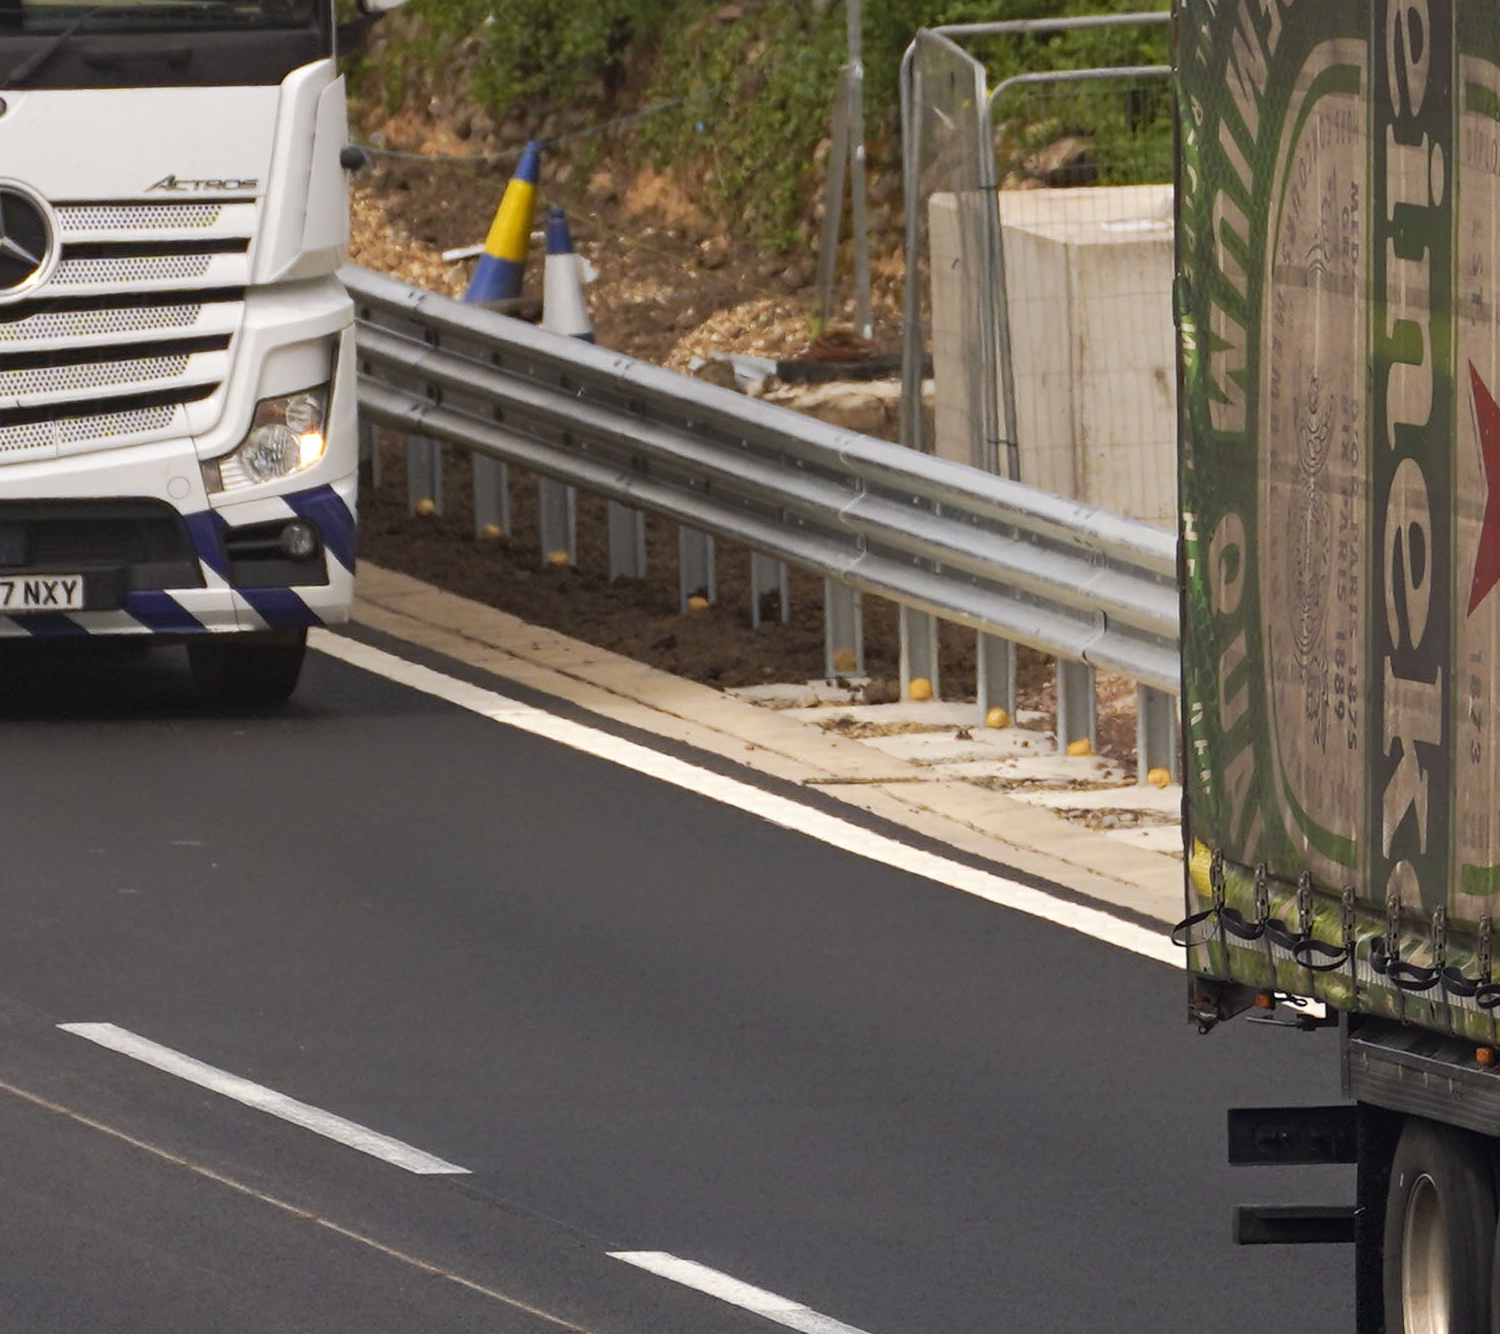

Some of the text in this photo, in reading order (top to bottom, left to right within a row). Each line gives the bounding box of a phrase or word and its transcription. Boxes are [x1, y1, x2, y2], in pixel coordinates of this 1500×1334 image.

[143, 174, 257, 192] ACTROS
[23, 580, 77, 606] NXY
[1333, 630, 1346, 724] 1889
[1346, 664, 1358, 752] 1875
[1466, 650, 1482, 764] 1873
